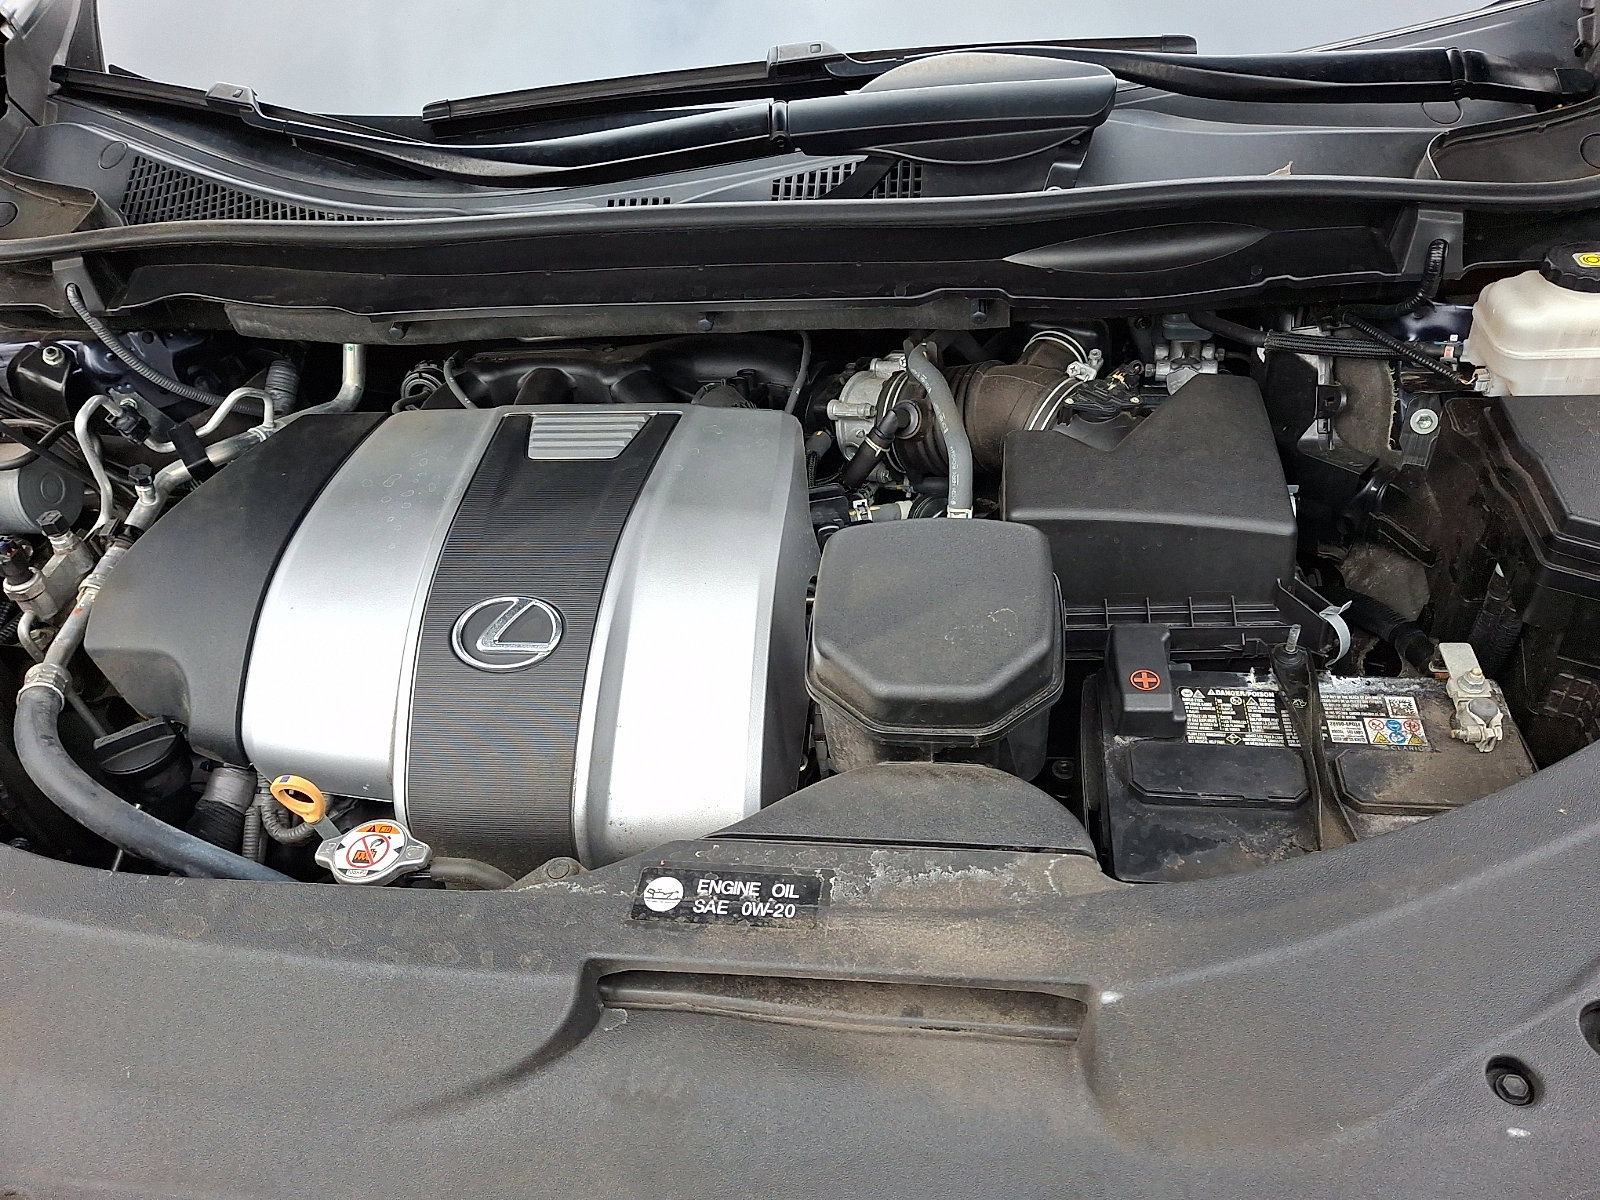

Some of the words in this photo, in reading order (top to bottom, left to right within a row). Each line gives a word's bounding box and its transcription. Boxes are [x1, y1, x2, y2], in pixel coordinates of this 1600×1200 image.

[697, 879, 761, 897] ENGINE
[772, 883, 800, 899] OIL
[692, 899, 730, 915] SAE
[741, 902, 796, 918] 0W-20
